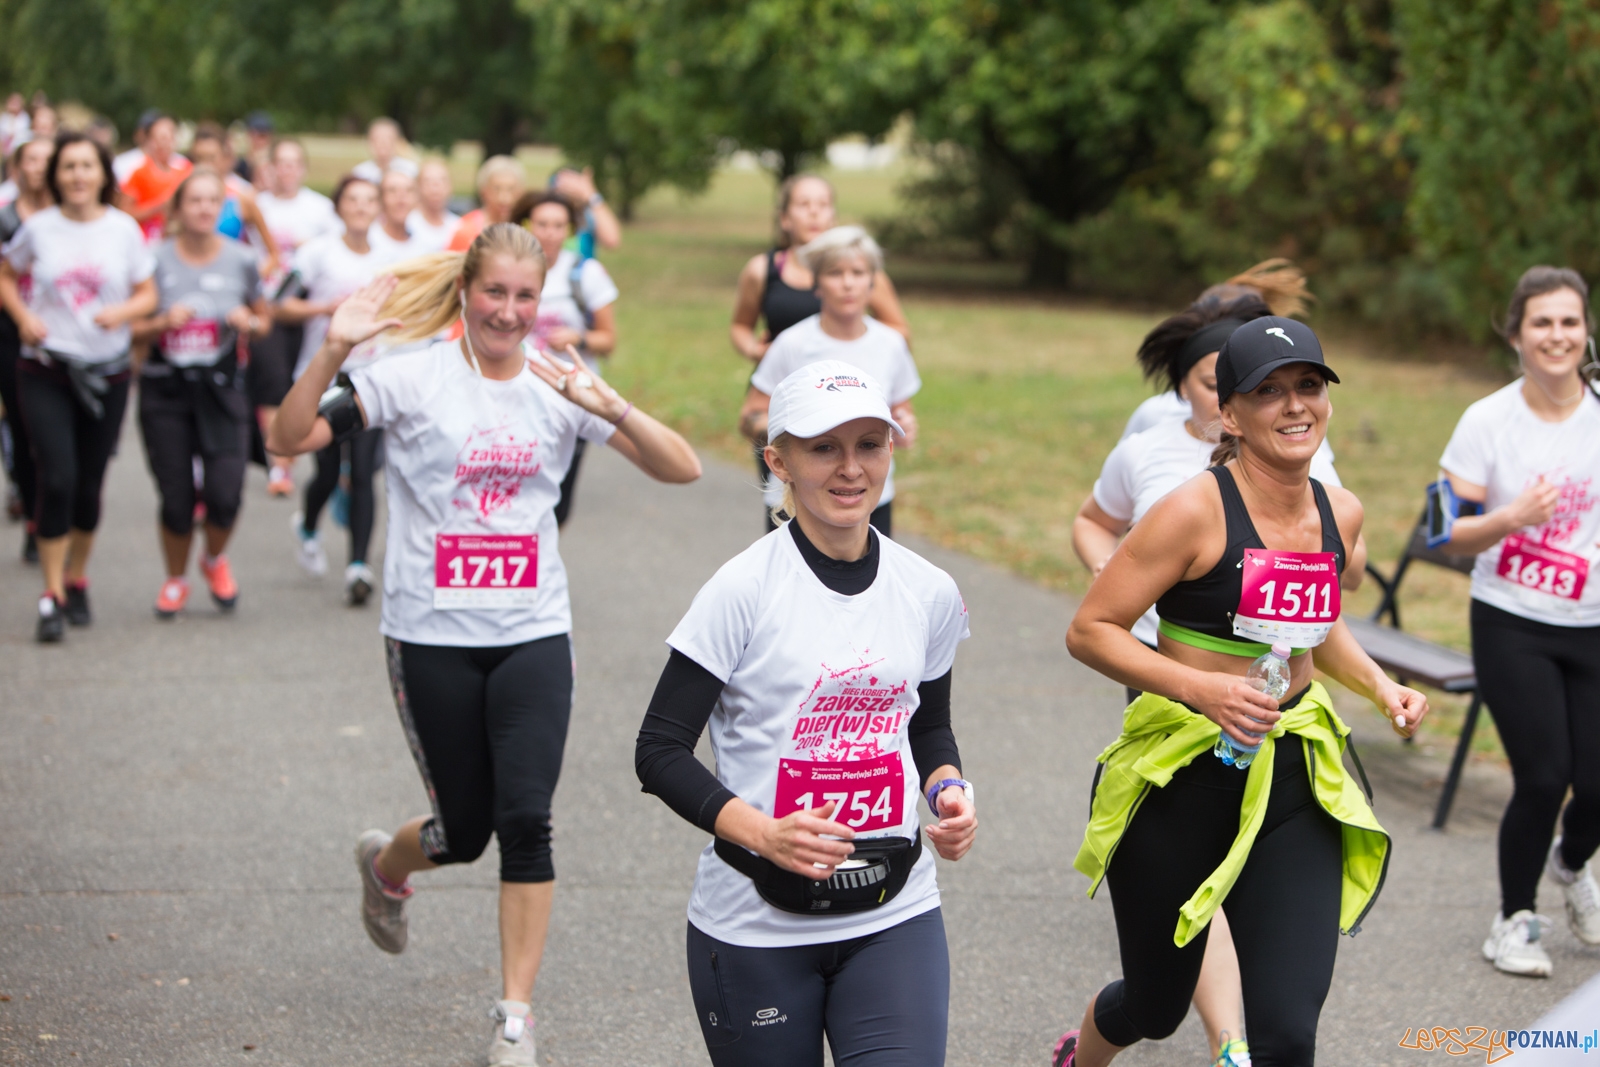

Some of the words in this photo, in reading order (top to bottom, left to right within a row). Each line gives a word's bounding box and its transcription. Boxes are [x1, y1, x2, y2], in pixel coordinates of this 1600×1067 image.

[447, 555, 530, 587] 1717
[1505, 554, 1577, 598] 1613
[1257, 580, 1333, 618] 1511
[842, 688, 861, 696] BIEG
[860, 688, 889, 697] KOBIET
[811, 695, 896, 713] zawsze
[795, 734, 825, 751] 2016
[811, 771, 841, 780] Zawsze
[842, 769, 872, 780] Pier(w)si
[872, 766, 889, 777] 2016
[794, 785, 893, 828] 1754
[751, 1014, 788, 1027] Kalenji
